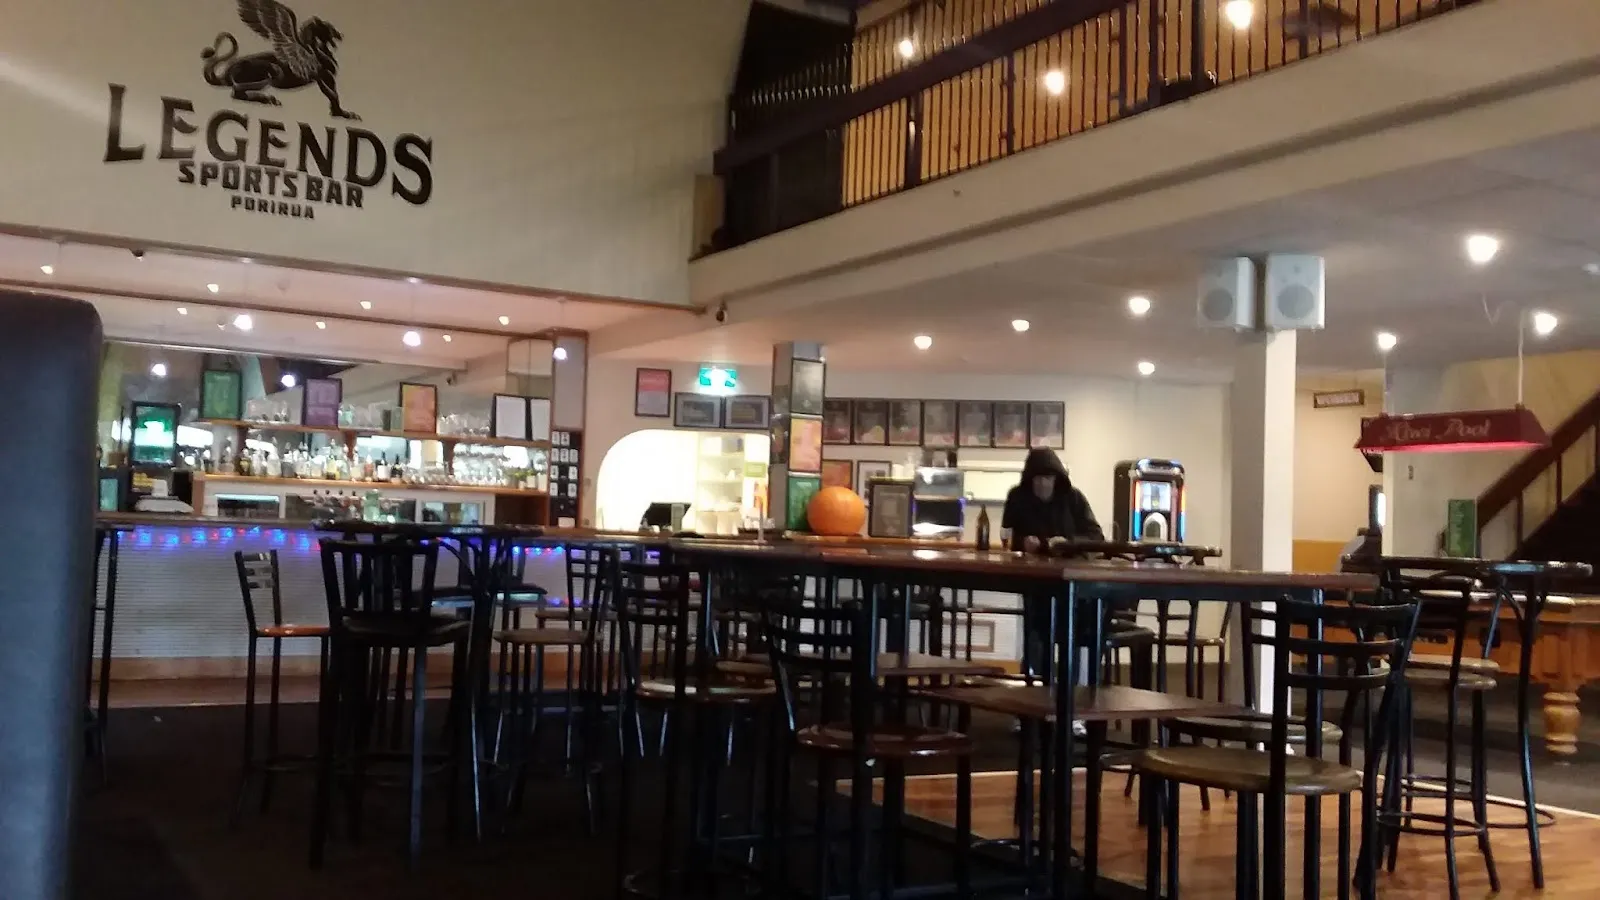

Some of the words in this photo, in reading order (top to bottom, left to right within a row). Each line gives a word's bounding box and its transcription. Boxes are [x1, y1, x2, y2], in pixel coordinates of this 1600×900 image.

[104, 83, 433, 205] LEGENDS
[178, 160, 299, 198] SPORTS
[304, 173, 364, 208] BAR
[230, 195, 315, 219] PORIRUA
[1435, 417, 1491, 440] Pool
